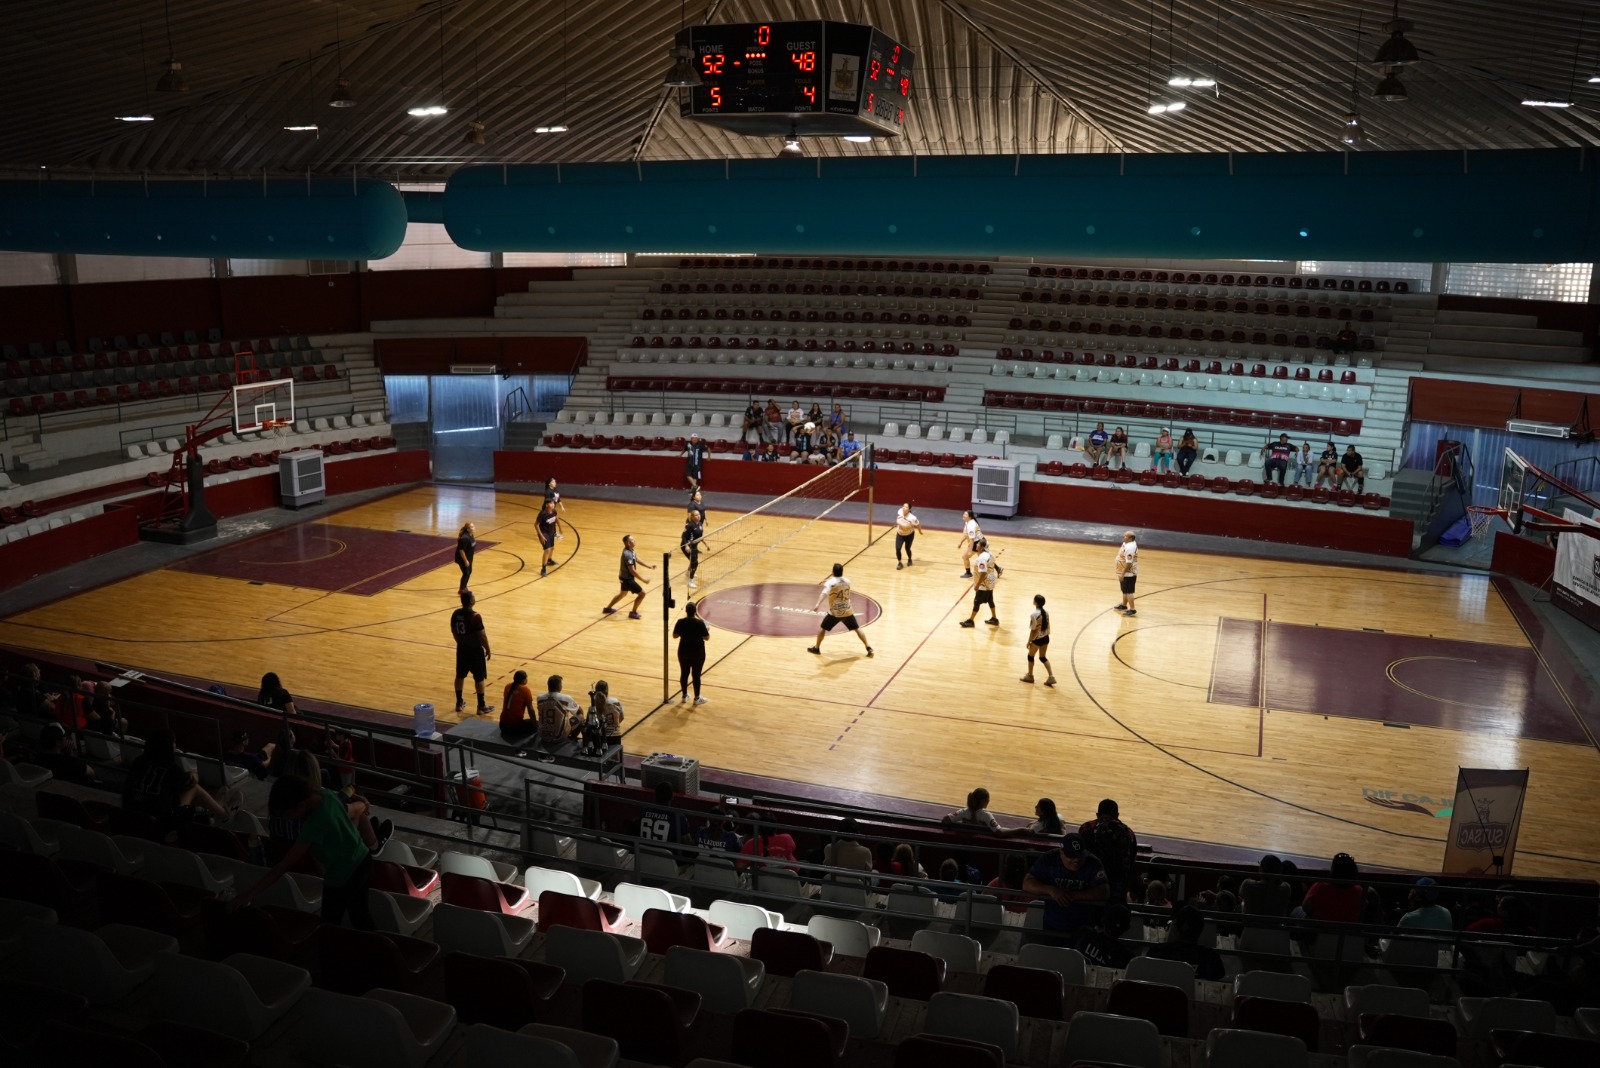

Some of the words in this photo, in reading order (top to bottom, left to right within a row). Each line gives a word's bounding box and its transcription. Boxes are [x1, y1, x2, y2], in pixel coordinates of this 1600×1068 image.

[699, 44, 724, 54] HOME
[786, 41, 817, 51] GUEST
[702, 53, 726, 75] 52
[791, 51, 816, 72] 48
[710, 86, 722, 107] 5
[803, 85, 816, 104] 4
[456, 621, 466, 635] 13
[1362, 787, 1398, 799] DIF
[645, 811, 668, 820] ESTRADA
[640, 817, 671, 842] 69
